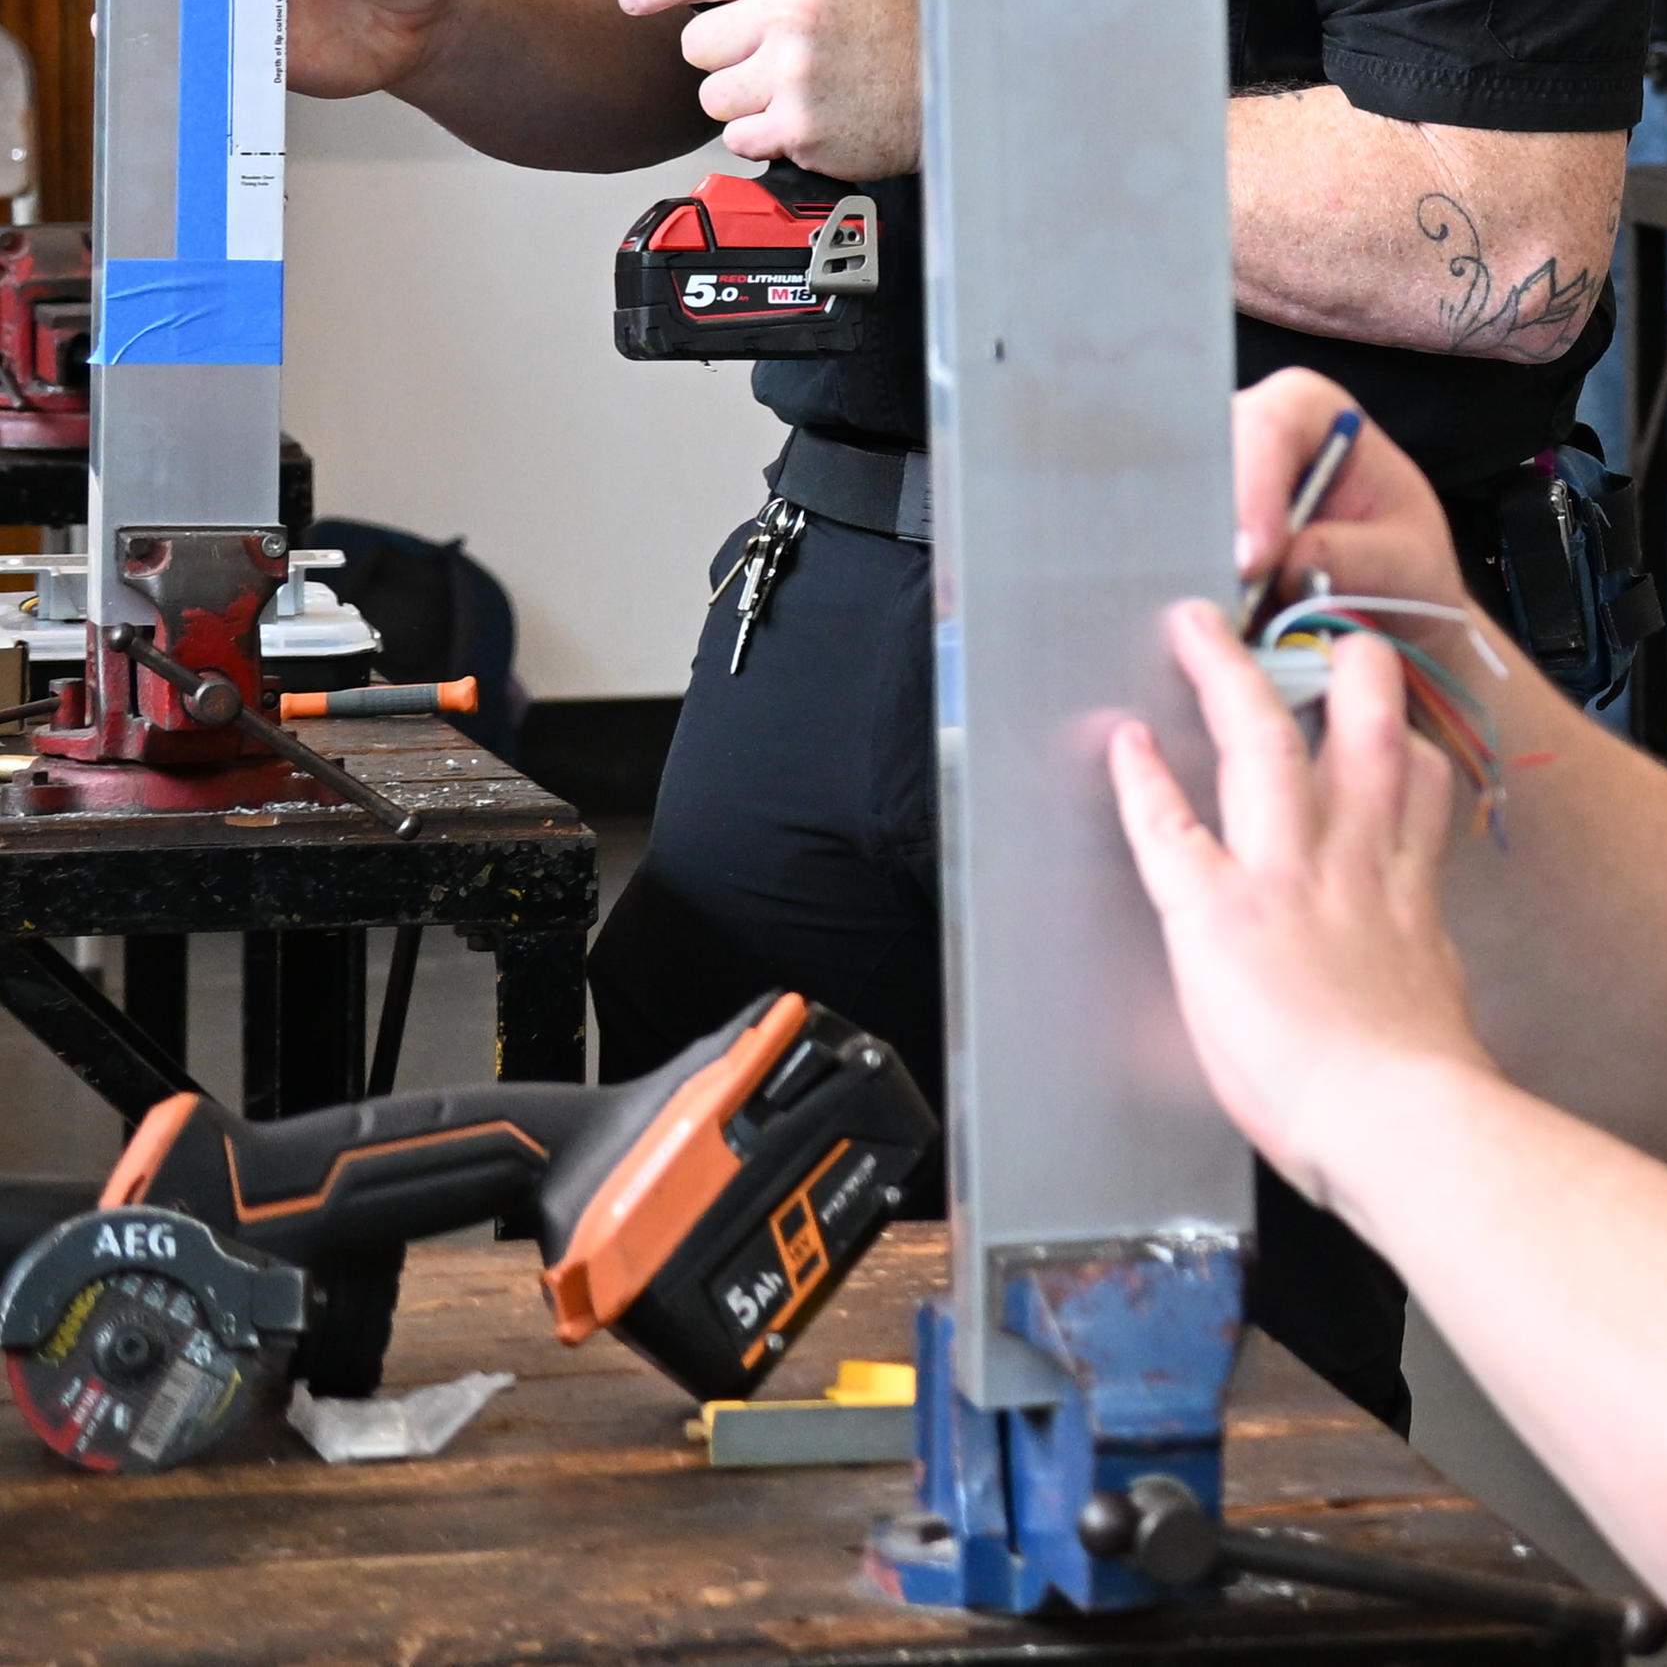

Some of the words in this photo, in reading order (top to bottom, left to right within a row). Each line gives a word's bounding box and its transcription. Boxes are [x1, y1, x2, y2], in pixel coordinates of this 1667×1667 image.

[275, 5, 283, 33] cutout
[274, 34, 285, 46] lip
[274, 47, 283, 56] of
[273, 59, 284, 84] Depth
[770, 288, 813, 302] M18
[92, 1222, 178, 1261] AEG
